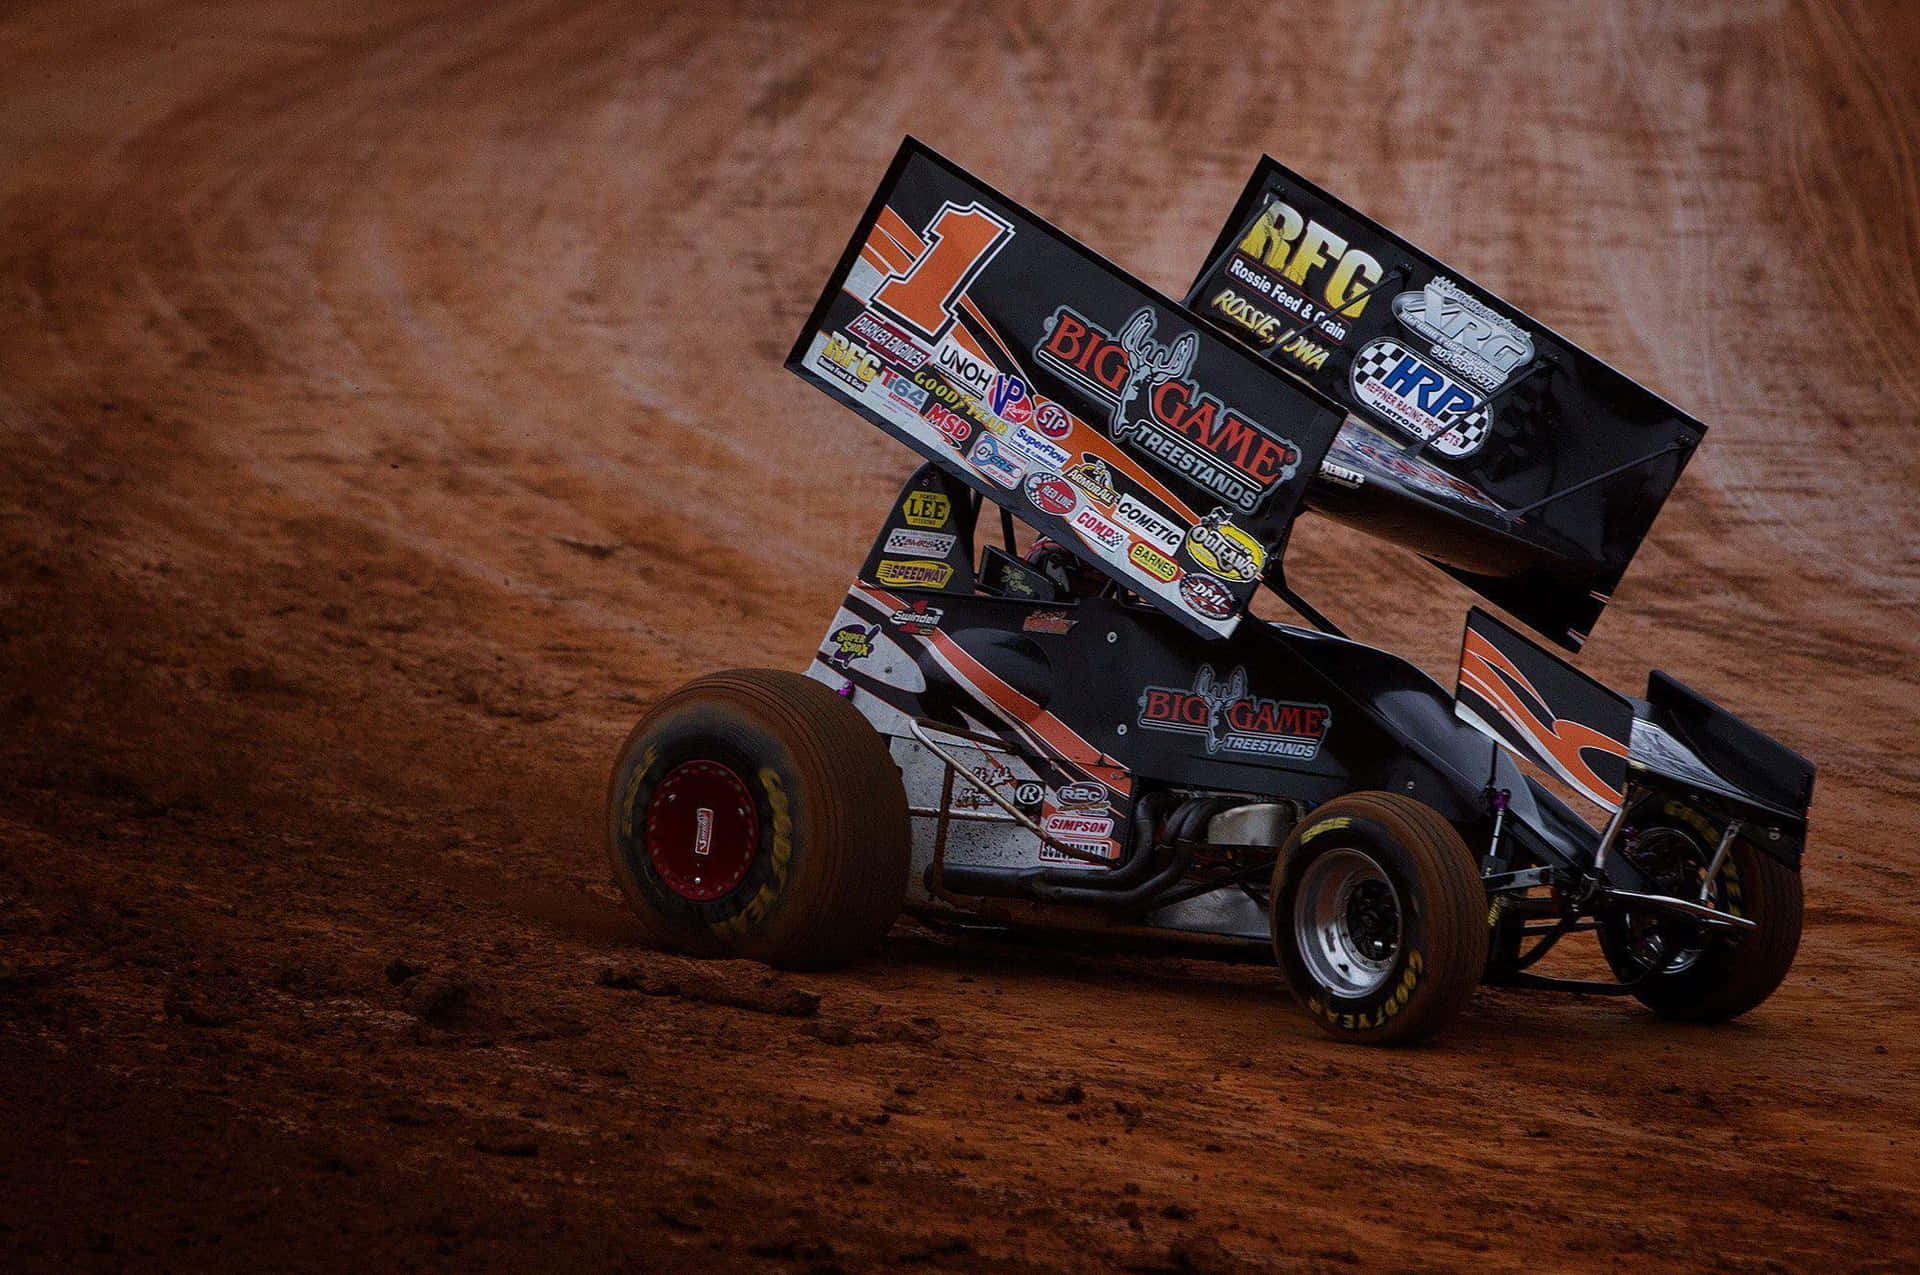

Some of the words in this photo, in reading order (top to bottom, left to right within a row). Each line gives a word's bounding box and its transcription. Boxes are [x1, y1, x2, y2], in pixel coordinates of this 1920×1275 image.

[867, 201, 1015, 345] 1
[1230, 258, 1271, 293] Rossie
[1270, 284, 1303, 313] Feed
[1301, 303, 1314, 320] &
[853, 317, 892, 345] PARKER
[884, 336, 926, 366] ENGINES
[940, 345, 992, 391] UNOH
[1381, 354, 1475, 417] HRP
[1430, 346, 1496, 392] 901-604-9377
[993, 373, 1025, 417] VP
[1047, 314, 1130, 391] BIG
[1153, 381, 1285, 485] GAME
[1397, 397, 1424, 424] RACING
[925, 403, 971, 441] MSD
[1037, 406, 1065, 431] STP
[1017, 428, 1067, 464] SuperFlow
[1135, 424, 1257, 508] TREESTANDS
[907, 498, 947, 520] LEE
[1077, 511, 1115, 538] COMP
[1118, 502, 1181, 546] COMETIC
[892, 564, 949, 583] SPEEDWAY
[1134, 545, 1177, 578] BARNES
[1194, 583, 1226, 606] DMI
[891, 609, 942, 625] Swindell
[1144, 691, 1208, 725] BIG
[1229, 701, 1328, 737] GAME
[1226, 735, 1317, 757] TREESTANDS
[1050, 818, 1108, 833] SIMPSON
